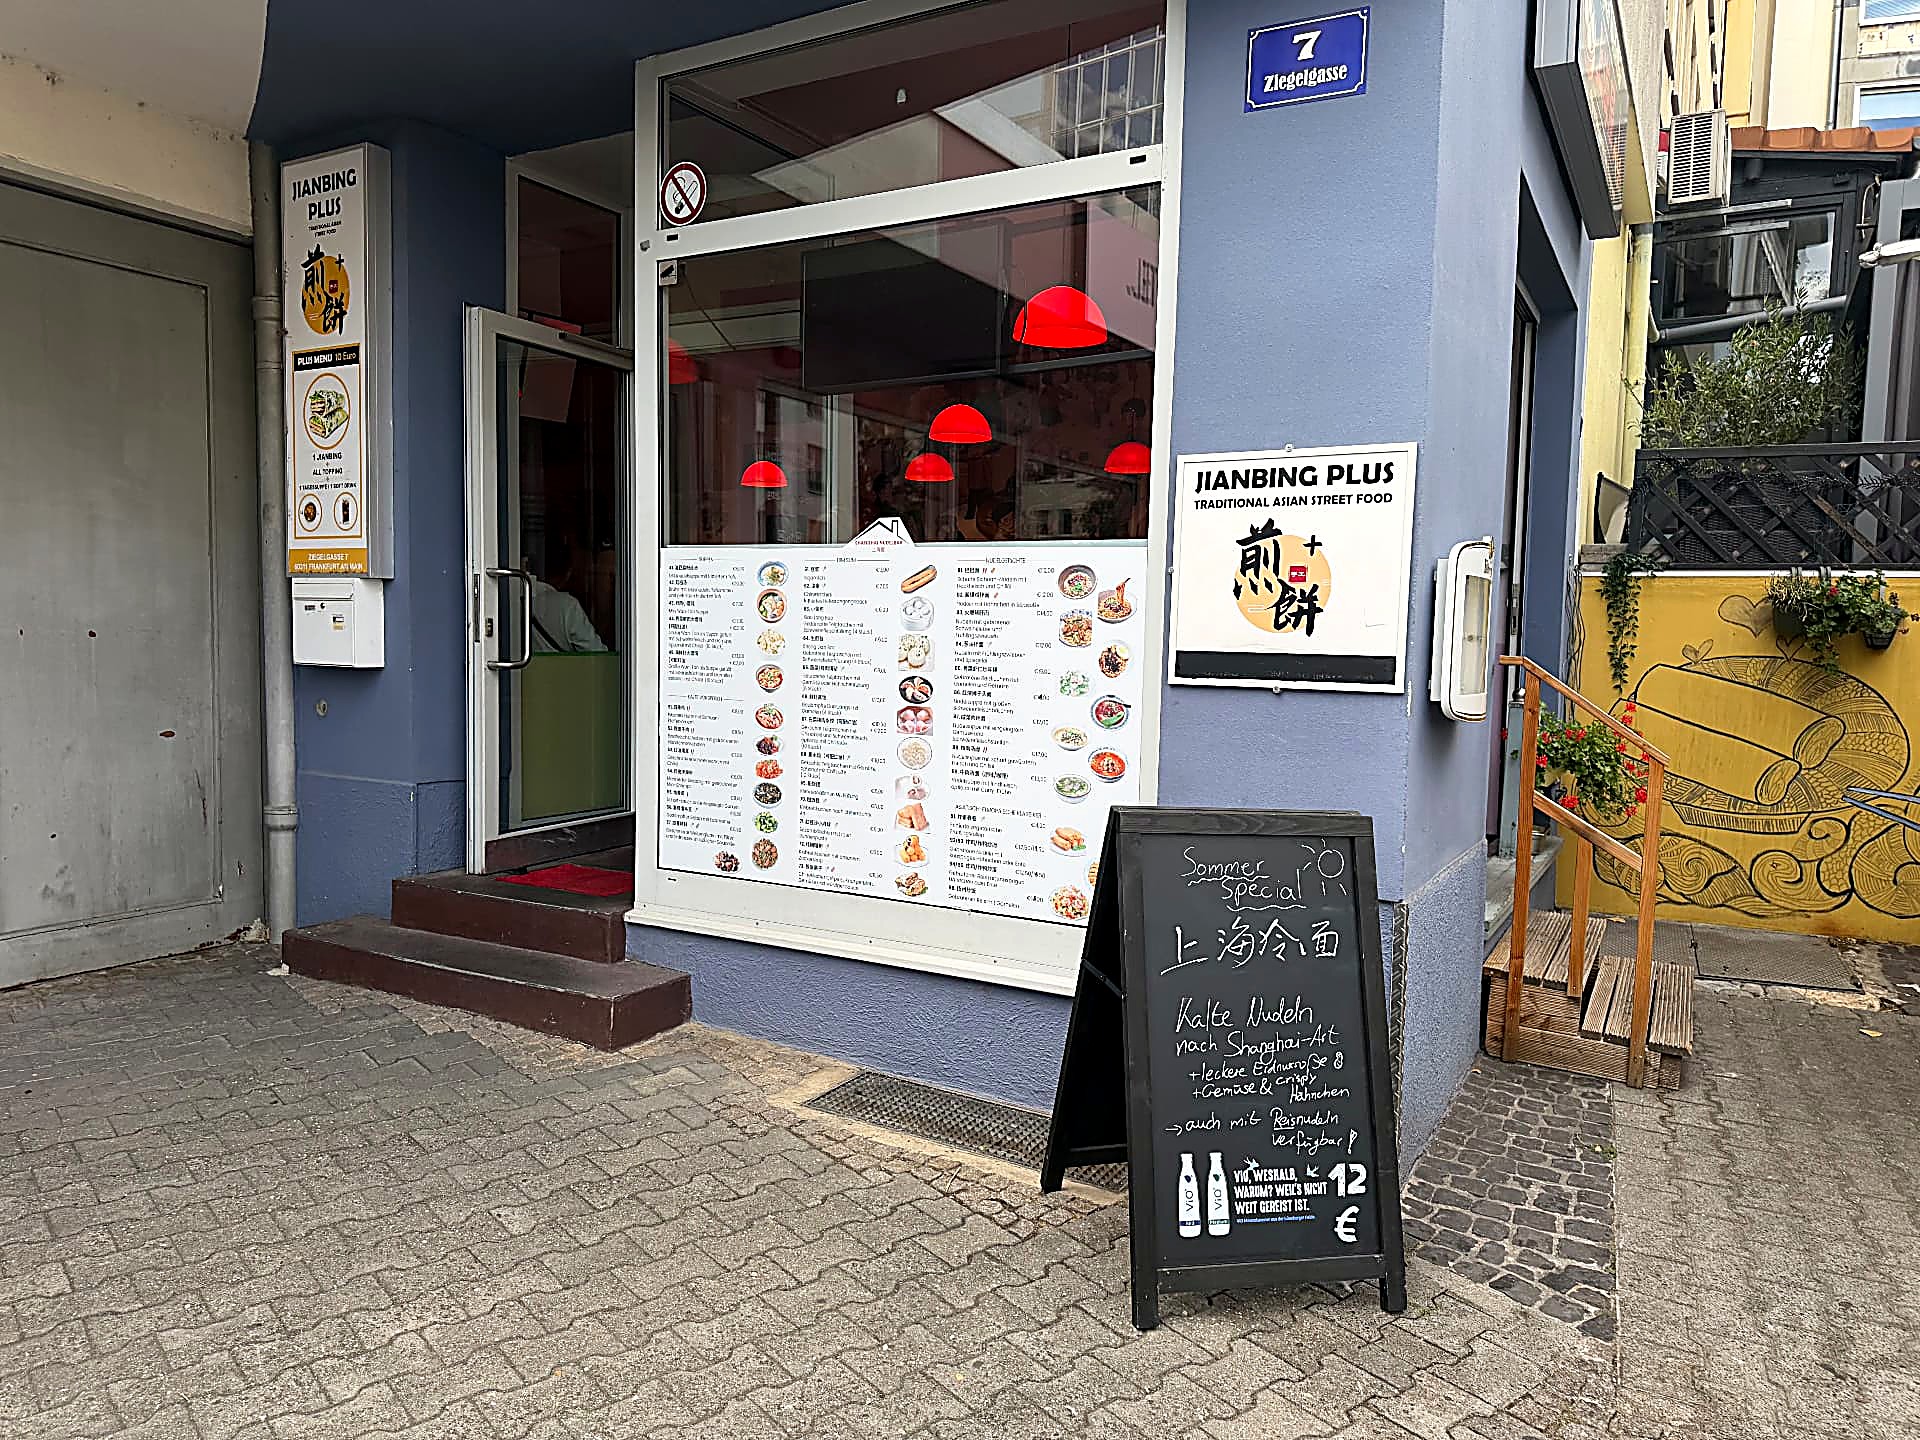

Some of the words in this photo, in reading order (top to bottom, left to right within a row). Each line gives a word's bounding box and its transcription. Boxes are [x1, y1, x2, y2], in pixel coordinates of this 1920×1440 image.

[1292, 30, 1322, 61] 7
[1264, 64, 1348, 93] Ziegelgasse
[292, 168, 357, 201] JIANBING
[308, 196, 341, 221] PLUS
[297, 356, 313, 366] PLUS
[313, 353, 333, 364] MENU
[335, 352, 342, 361] 10
[342, 351, 357, 361] Euro
[317, 452, 343, 461] JIANBING
[323, 467, 343, 475] TOPPING
[1194, 465, 1318, 494] JIANBING
[1326, 461, 1395, 486] PLUS
[1194, 497, 1270, 510] TRADITIONAL
[1272, 496, 1308, 507] ASIAN
[1311, 494, 1353, 506] STREET
[1356, 493, 1394, 504] FOOD
[1180, 846, 1264, 877] Sommer
[1160, 916, 1339, 976] 上海冷面
[1175, 997, 1233, 1032] Kalte
[1246, 995, 1313, 1027] Nudeln
[1176, 1034, 1218, 1056] nach
[1223, 1024, 1341, 1066] Shanghai-Art
[1259, 1077, 1274, 1095] &
[1275, 1073, 1318, 1087] crispy
[1289, 1084, 1350, 1104] Hähnchen
[1185, 1112, 1221, 1132] auch
[1230, 1111, 1261, 1129] mit
[1270, 1107, 1338, 1128] Reisnudeln
[1271, 1130, 1343, 1156] verfügbar
[1252, 1167, 1298, 1182] WESHALB,
[1327, 1162, 1367, 1199] 12
[1233, 1185, 1273, 1199] WARUM?
[1303, 1182, 1328, 1195] NICHT
[1234, 1201, 1258, 1215] WEIT
[1259, 1199, 1293, 1214] GEREIST
[1294, 1198, 1310, 1212] IST.
[1333, 1205, 1360, 1243] €
